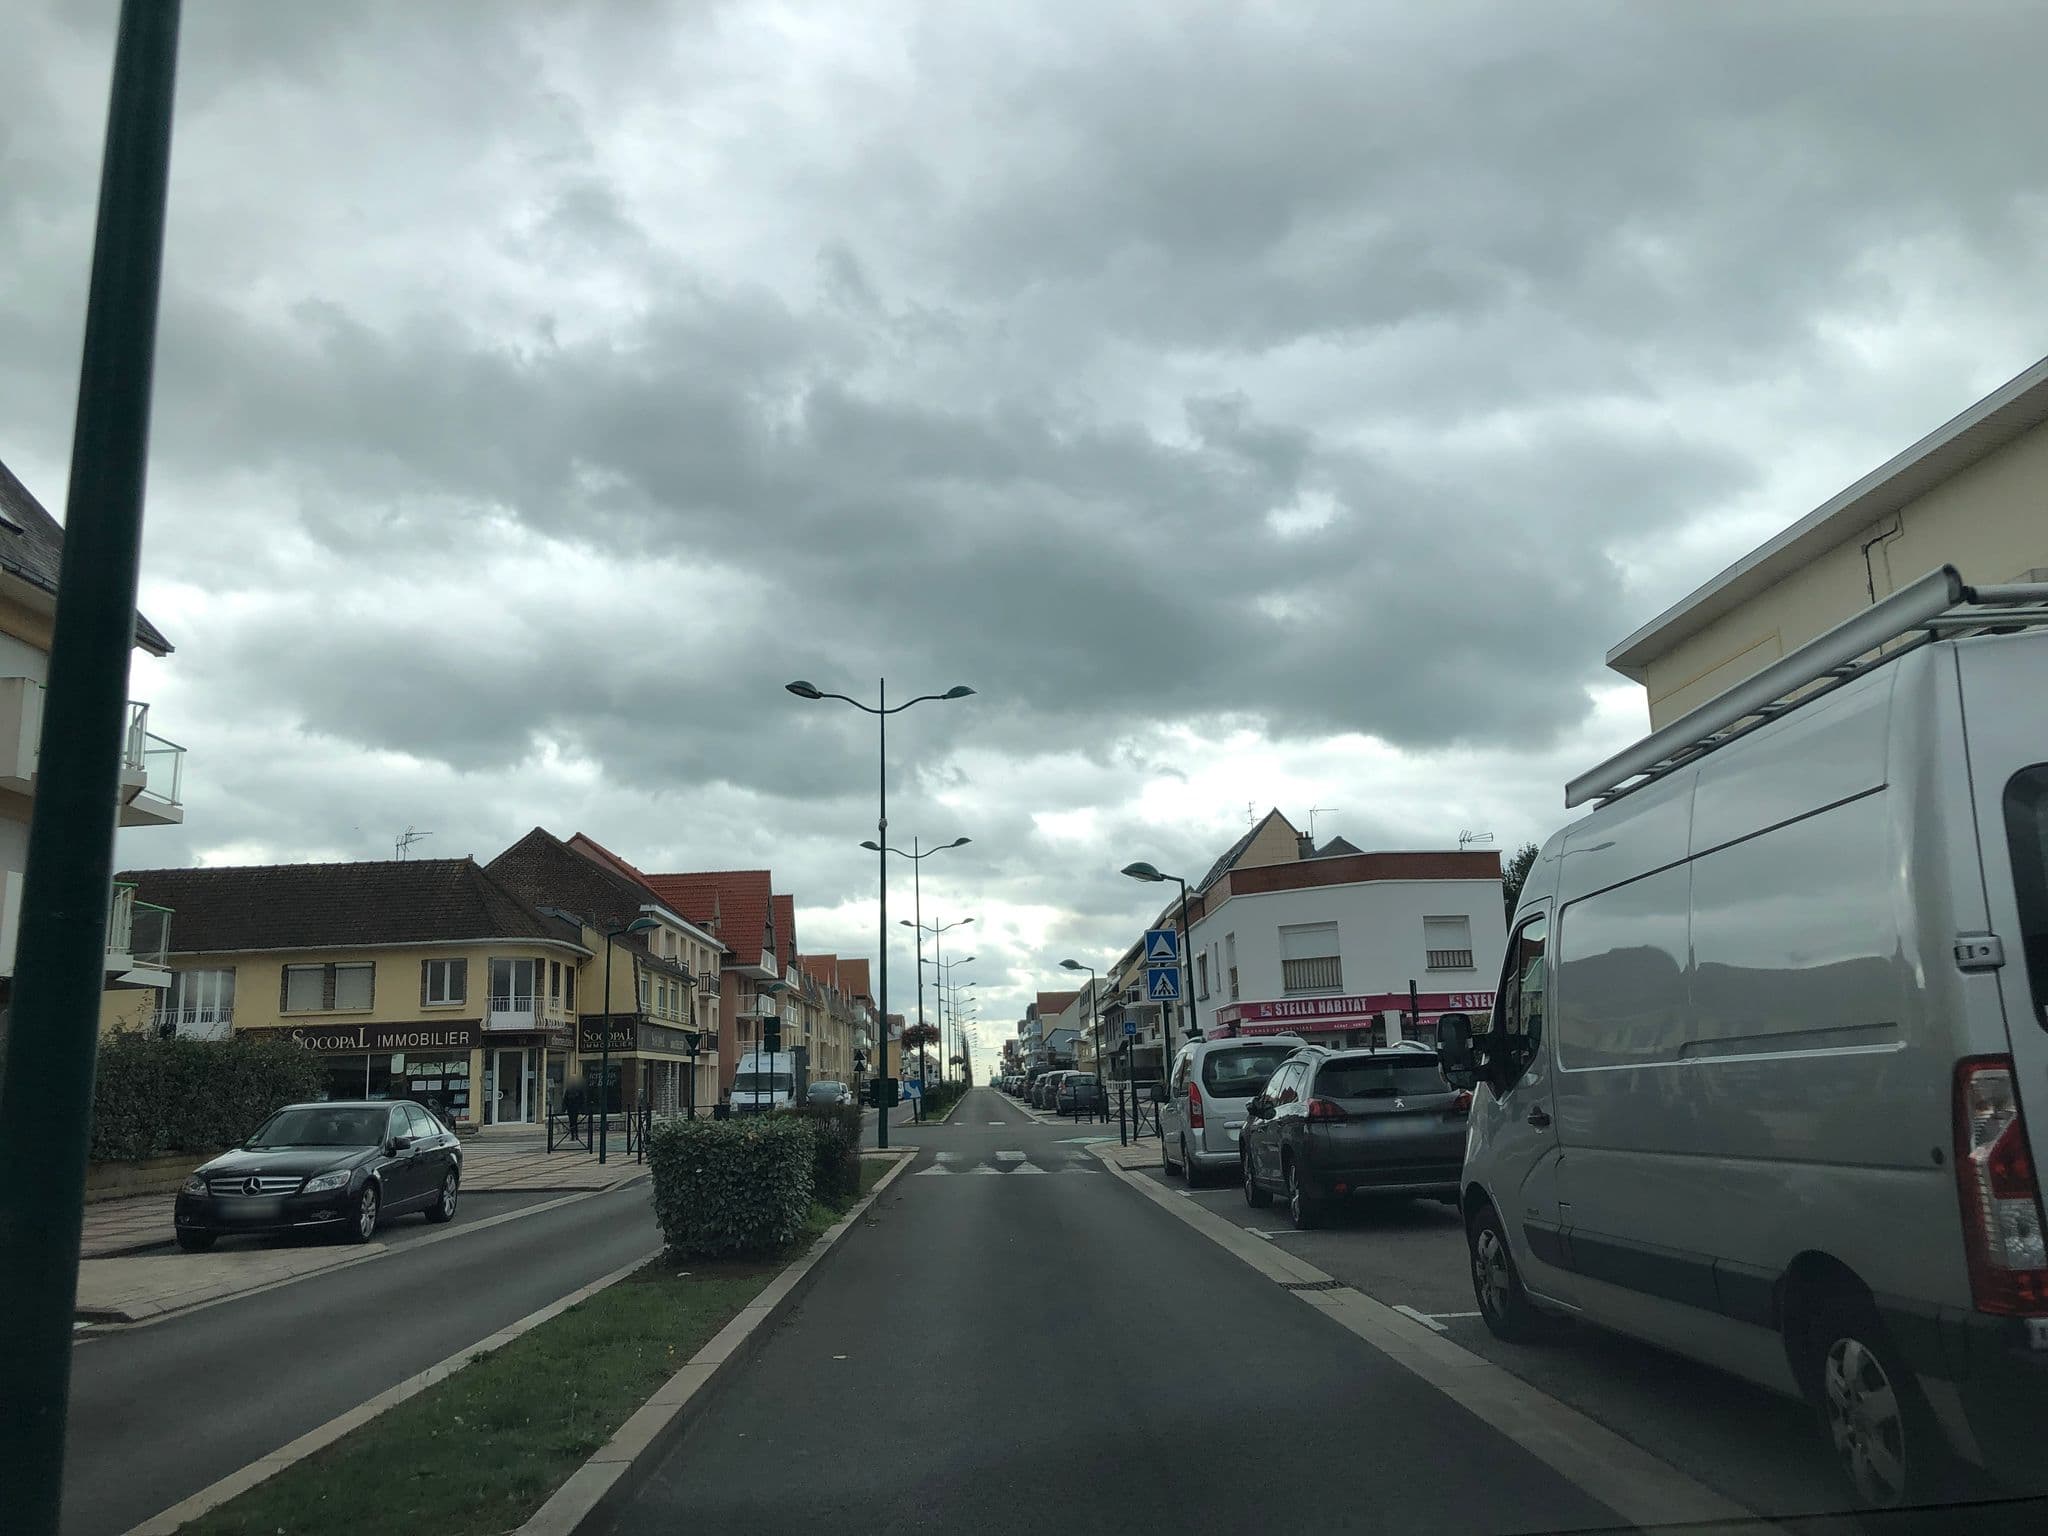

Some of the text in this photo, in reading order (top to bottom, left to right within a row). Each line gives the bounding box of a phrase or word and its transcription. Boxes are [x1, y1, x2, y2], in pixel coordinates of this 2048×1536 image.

[1275, 998, 1368, 1016] STELLA HABITAT
[377, 1031, 470, 1048] IMMOBILIER
